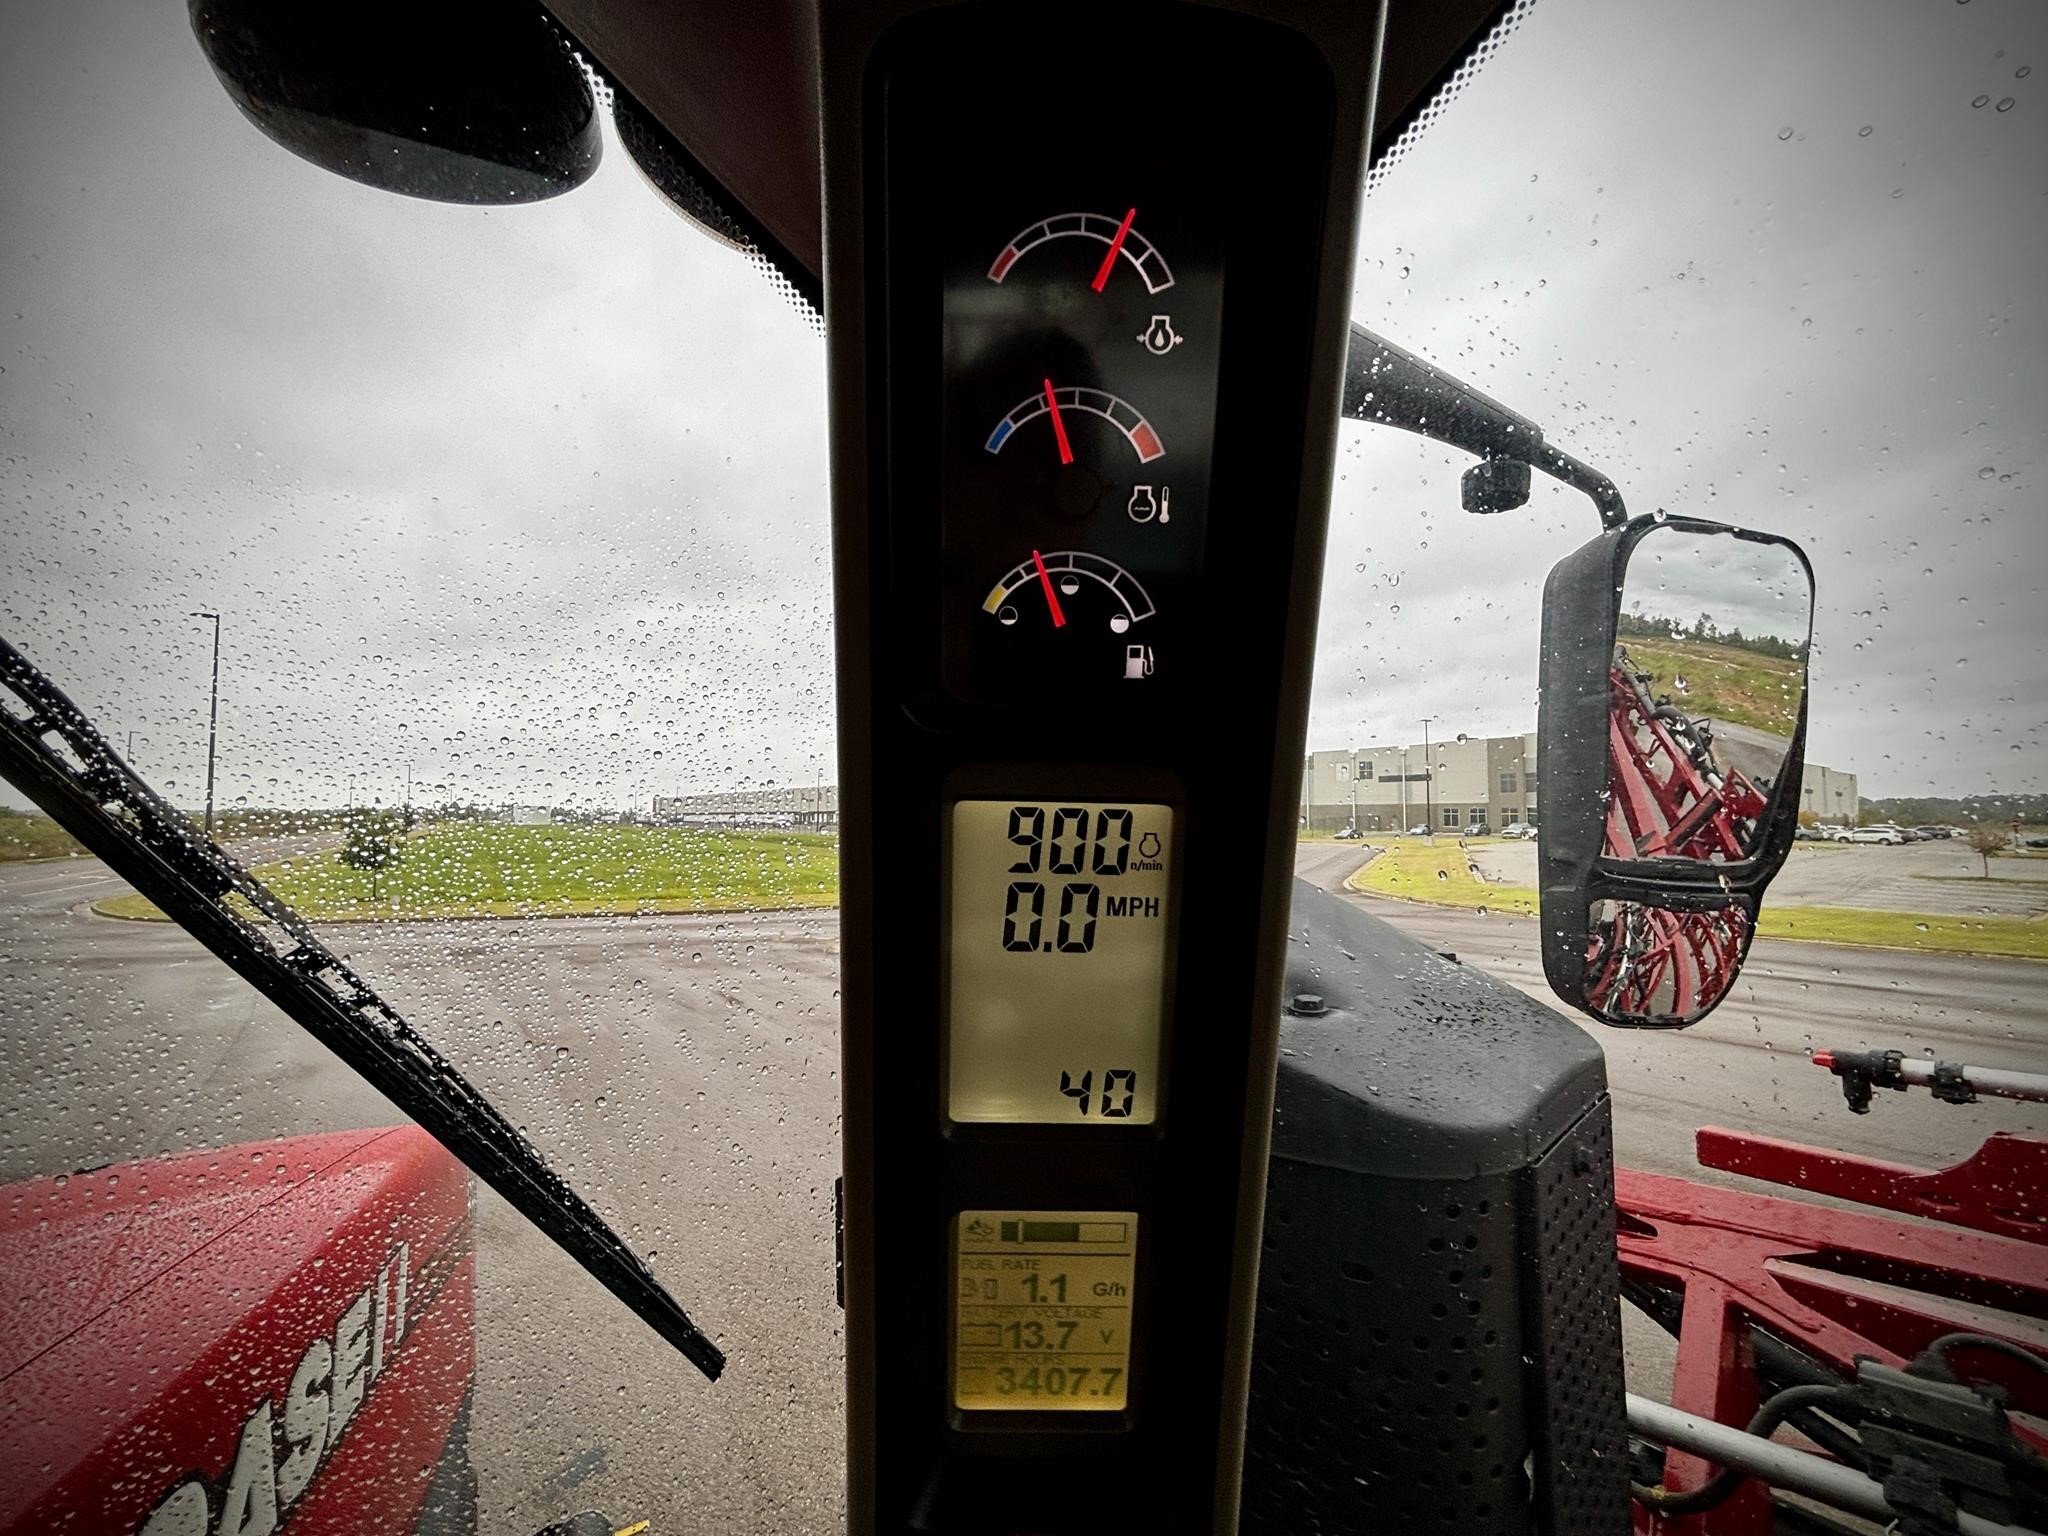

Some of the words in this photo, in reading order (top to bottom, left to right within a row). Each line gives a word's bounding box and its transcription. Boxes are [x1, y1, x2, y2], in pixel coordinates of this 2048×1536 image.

[1008, 806, 1133, 876] 900
[1130, 860, 1163, 872] n/min
[1002, 882, 1100, 953] 0.0
[1106, 896, 1159, 917] MPH
[1059, 1069, 1136, 1117] 40
[1002, 1259, 1041, 1271] RATE
[1022, 1273, 1067, 1303] 1.1
[1093, 1282, 1127, 1297] G/h
[1005, 1321, 1079, 1350] 13.7
[996, 1366, 1123, 1396] 3407.7
